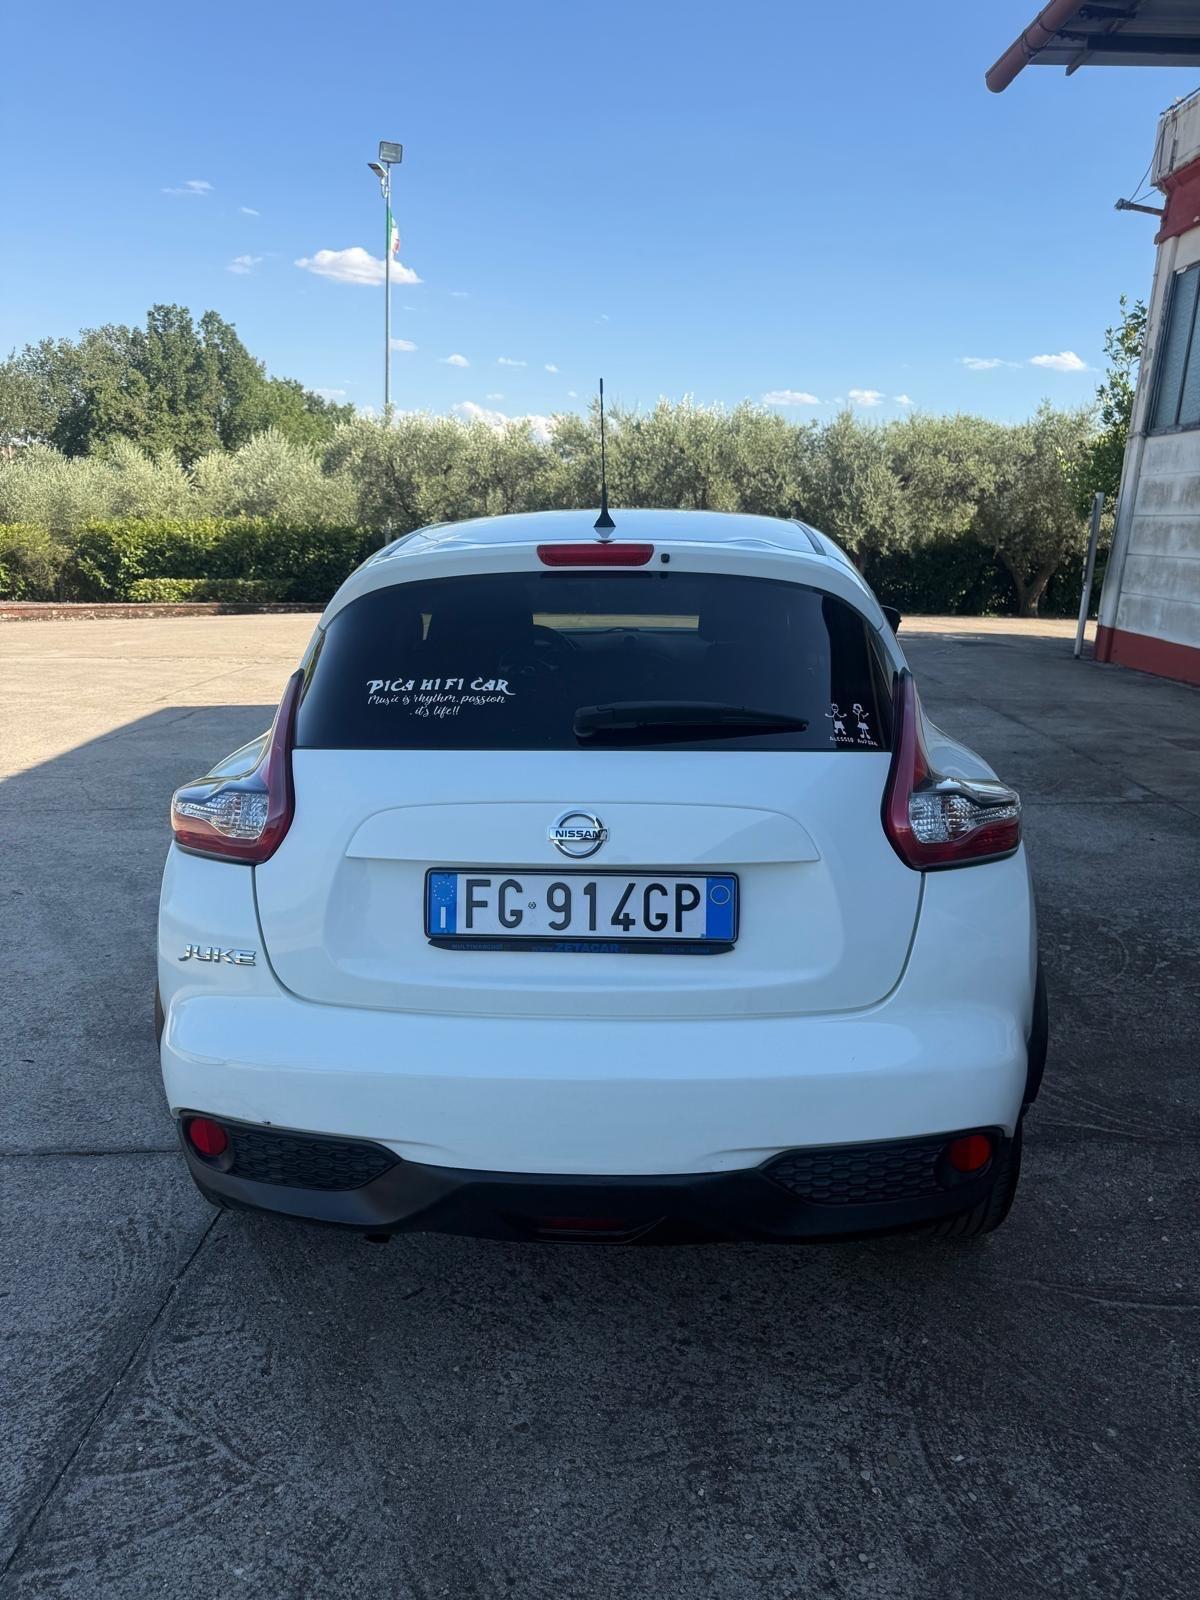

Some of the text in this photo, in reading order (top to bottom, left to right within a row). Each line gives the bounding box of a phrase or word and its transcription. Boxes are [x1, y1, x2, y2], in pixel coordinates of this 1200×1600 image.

[366, 678, 415, 694] PICA
[470, 677, 516, 695] CAR
[367, 695, 399, 705] Music
[402, 695, 410, 705] is
[460, 695, 506, 705] passion
[555, 830, 600, 838] NISSAN
[465, 879, 524, 929] FG
[546, 882, 701, 932] 914GP
[178, 944, 257, 966] JUKE
